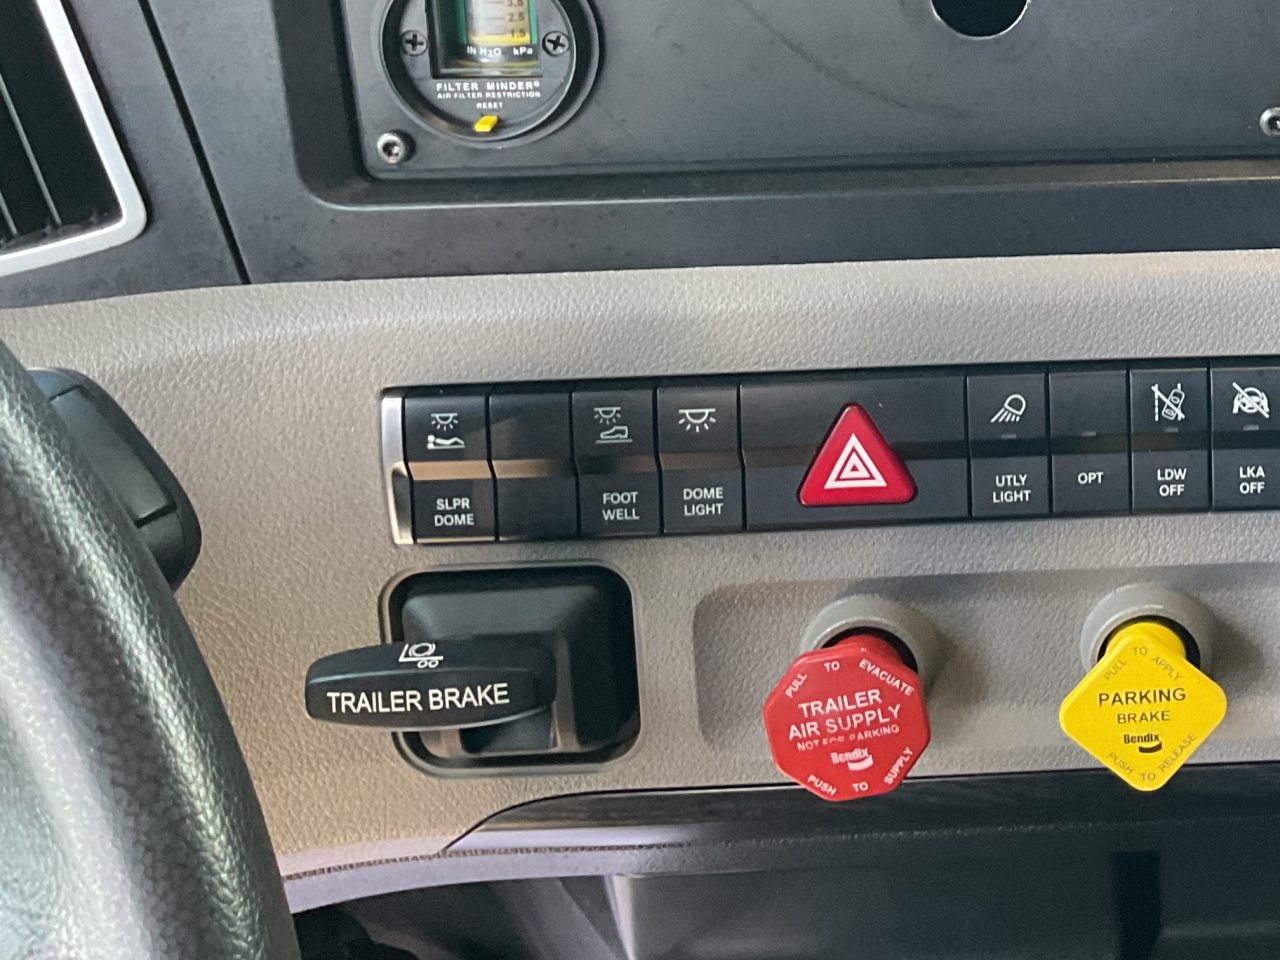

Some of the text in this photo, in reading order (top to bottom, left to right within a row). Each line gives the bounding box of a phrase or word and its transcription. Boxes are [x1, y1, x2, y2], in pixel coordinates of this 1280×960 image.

[436, 82, 478, 91] FILTER
[1077, 472, 1104, 485] OPT
[1157, 468, 1187, 481] LDW
[1239, 466, 1265, 479] LKA
[995, 474, 1027, 487] UTLY
[1239, 481, 1265, 494] OFF
[683, 487, 724, 501] DOME
[992, 490, 1031, 503] LIGHT
[1159, 484, 1185, 497] OFF
[436, 498, 470, 511] SLPR
[602, 492, 638, 505] FOOT
[602, 508, 640, 522] WELL
[684, 503, 724, 517] LIGHT
[434, 513, 475, 527] DOME
[1104, 646, 1183, 681] PULL TO APPLY
[785, 658, 915, 698] PULL TO EVACUATE
[327, 683, 510, 714] TRAILER BRAKE
[798, 689, 882, 718] TRAILER
[1098, 687, 1186, 707] PARKING
[789, 704, 901, 740] AIR SUPPLY
[1117, 710, 1171, 724] BRAKE
[797, 739, 819, 751] NOT
[850, 724, 900, 741] PARKING
[1124, 733, 1160, 745] Bendix
[831, 747, 869, 764] Bendix
[1108, 732, 1196, 781] PUSH TO RELEASE
[807, 746, 914, 796] PUSH TO SUPPLY
